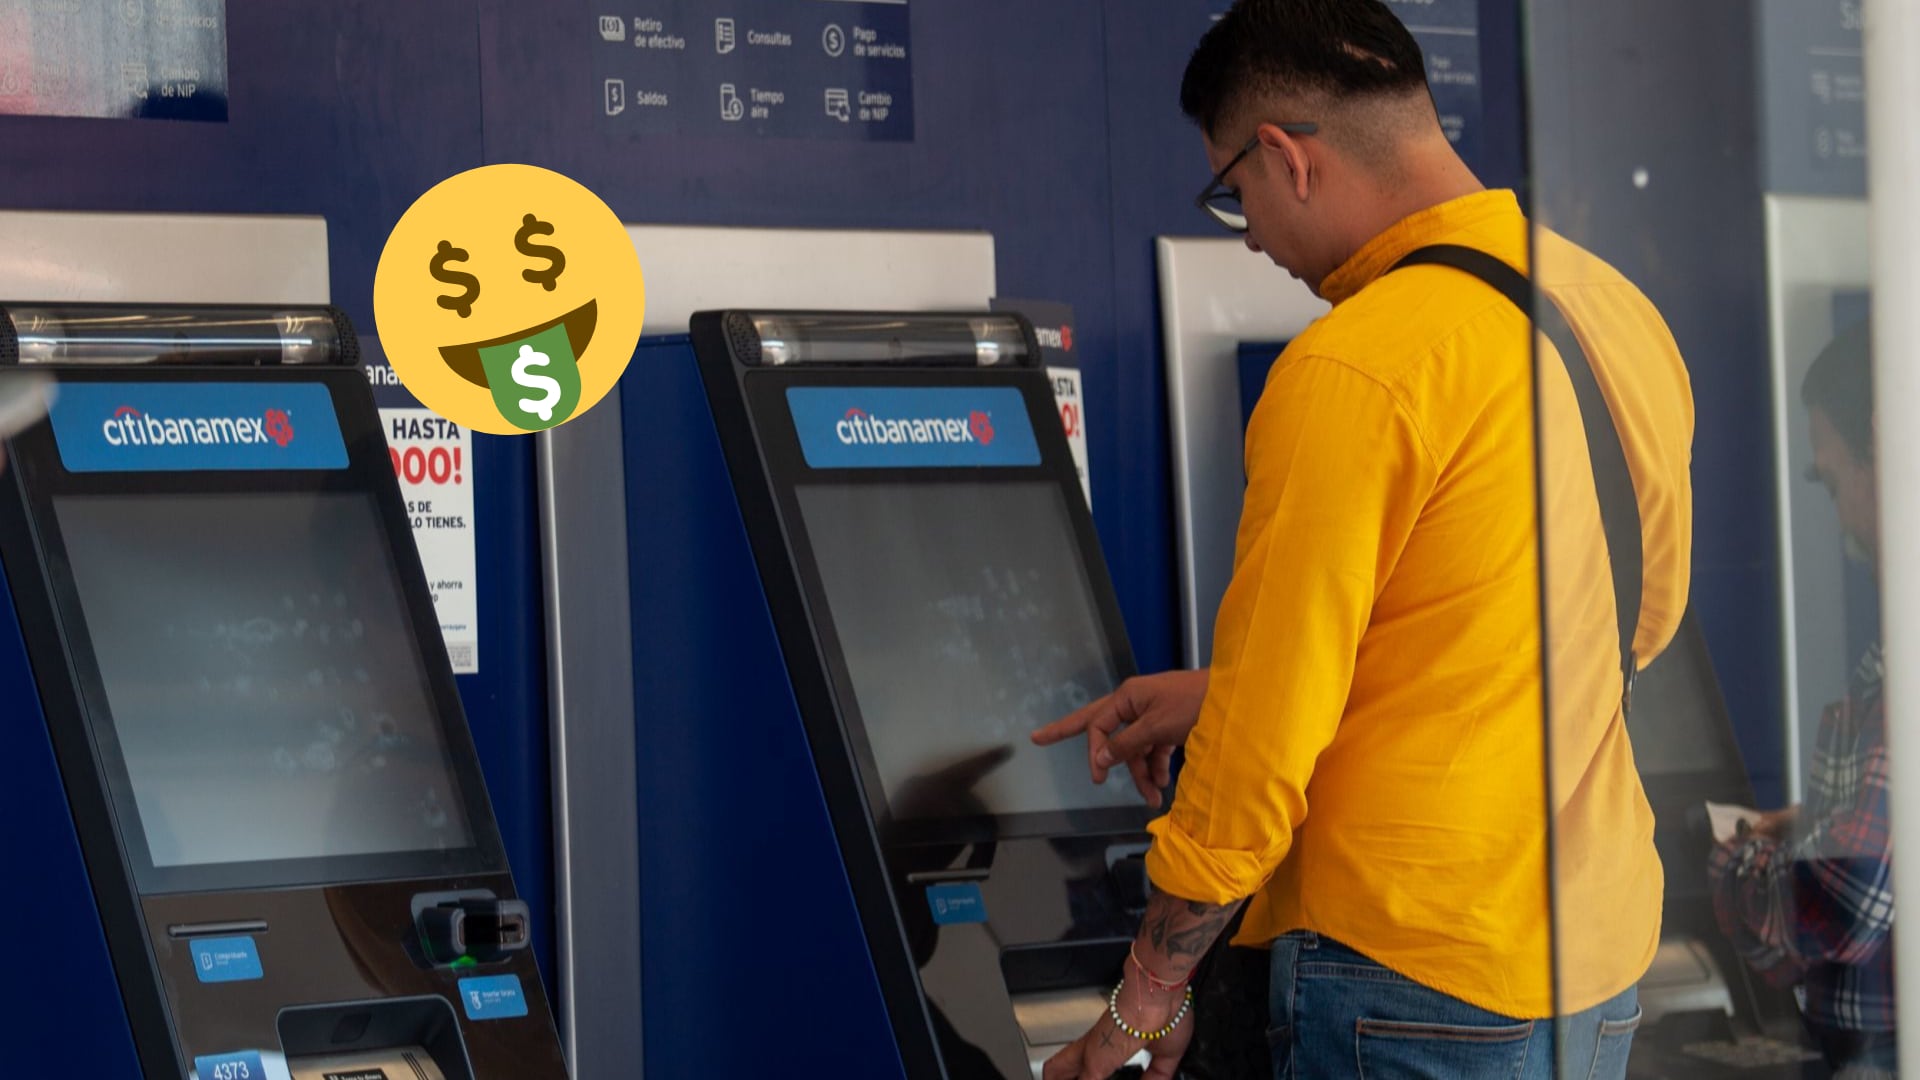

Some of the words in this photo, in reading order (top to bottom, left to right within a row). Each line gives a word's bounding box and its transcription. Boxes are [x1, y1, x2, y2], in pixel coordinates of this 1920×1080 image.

[634, 17, 662, 32] Retiro
[635, 34, 647, 48] de
[648, 34, 686, 50] efectivo
[747, 30, 792, 46] Consultas
[854, 27, 877, 43] Pago
[854, 43, 866, 57] de
[867, 44, 906, 59] servicios
[161, 82, 175, 97] de
[177, 83, 196, 99] NIP
[637, 91, 668, 106] Saldos
[750, 88, 785, 105] Tiempo
[858, 91, 892, 107] Cambio
[751, 106, 769, 119] aire
[872, 107, 889, 122] NIP
[365, 364, 402, 386] ana
[103, 405, 269, 446] citibanamex
[392, 417, 461, 440] HASTA
[836, 407, 974, 445] citibanamex
[417, 500, 432, 513] DE
[425, 516, 467, 529] TIENES.
[436, 579, 463, 590] ahorra
[214, 1060, 250, 1080] 4373
